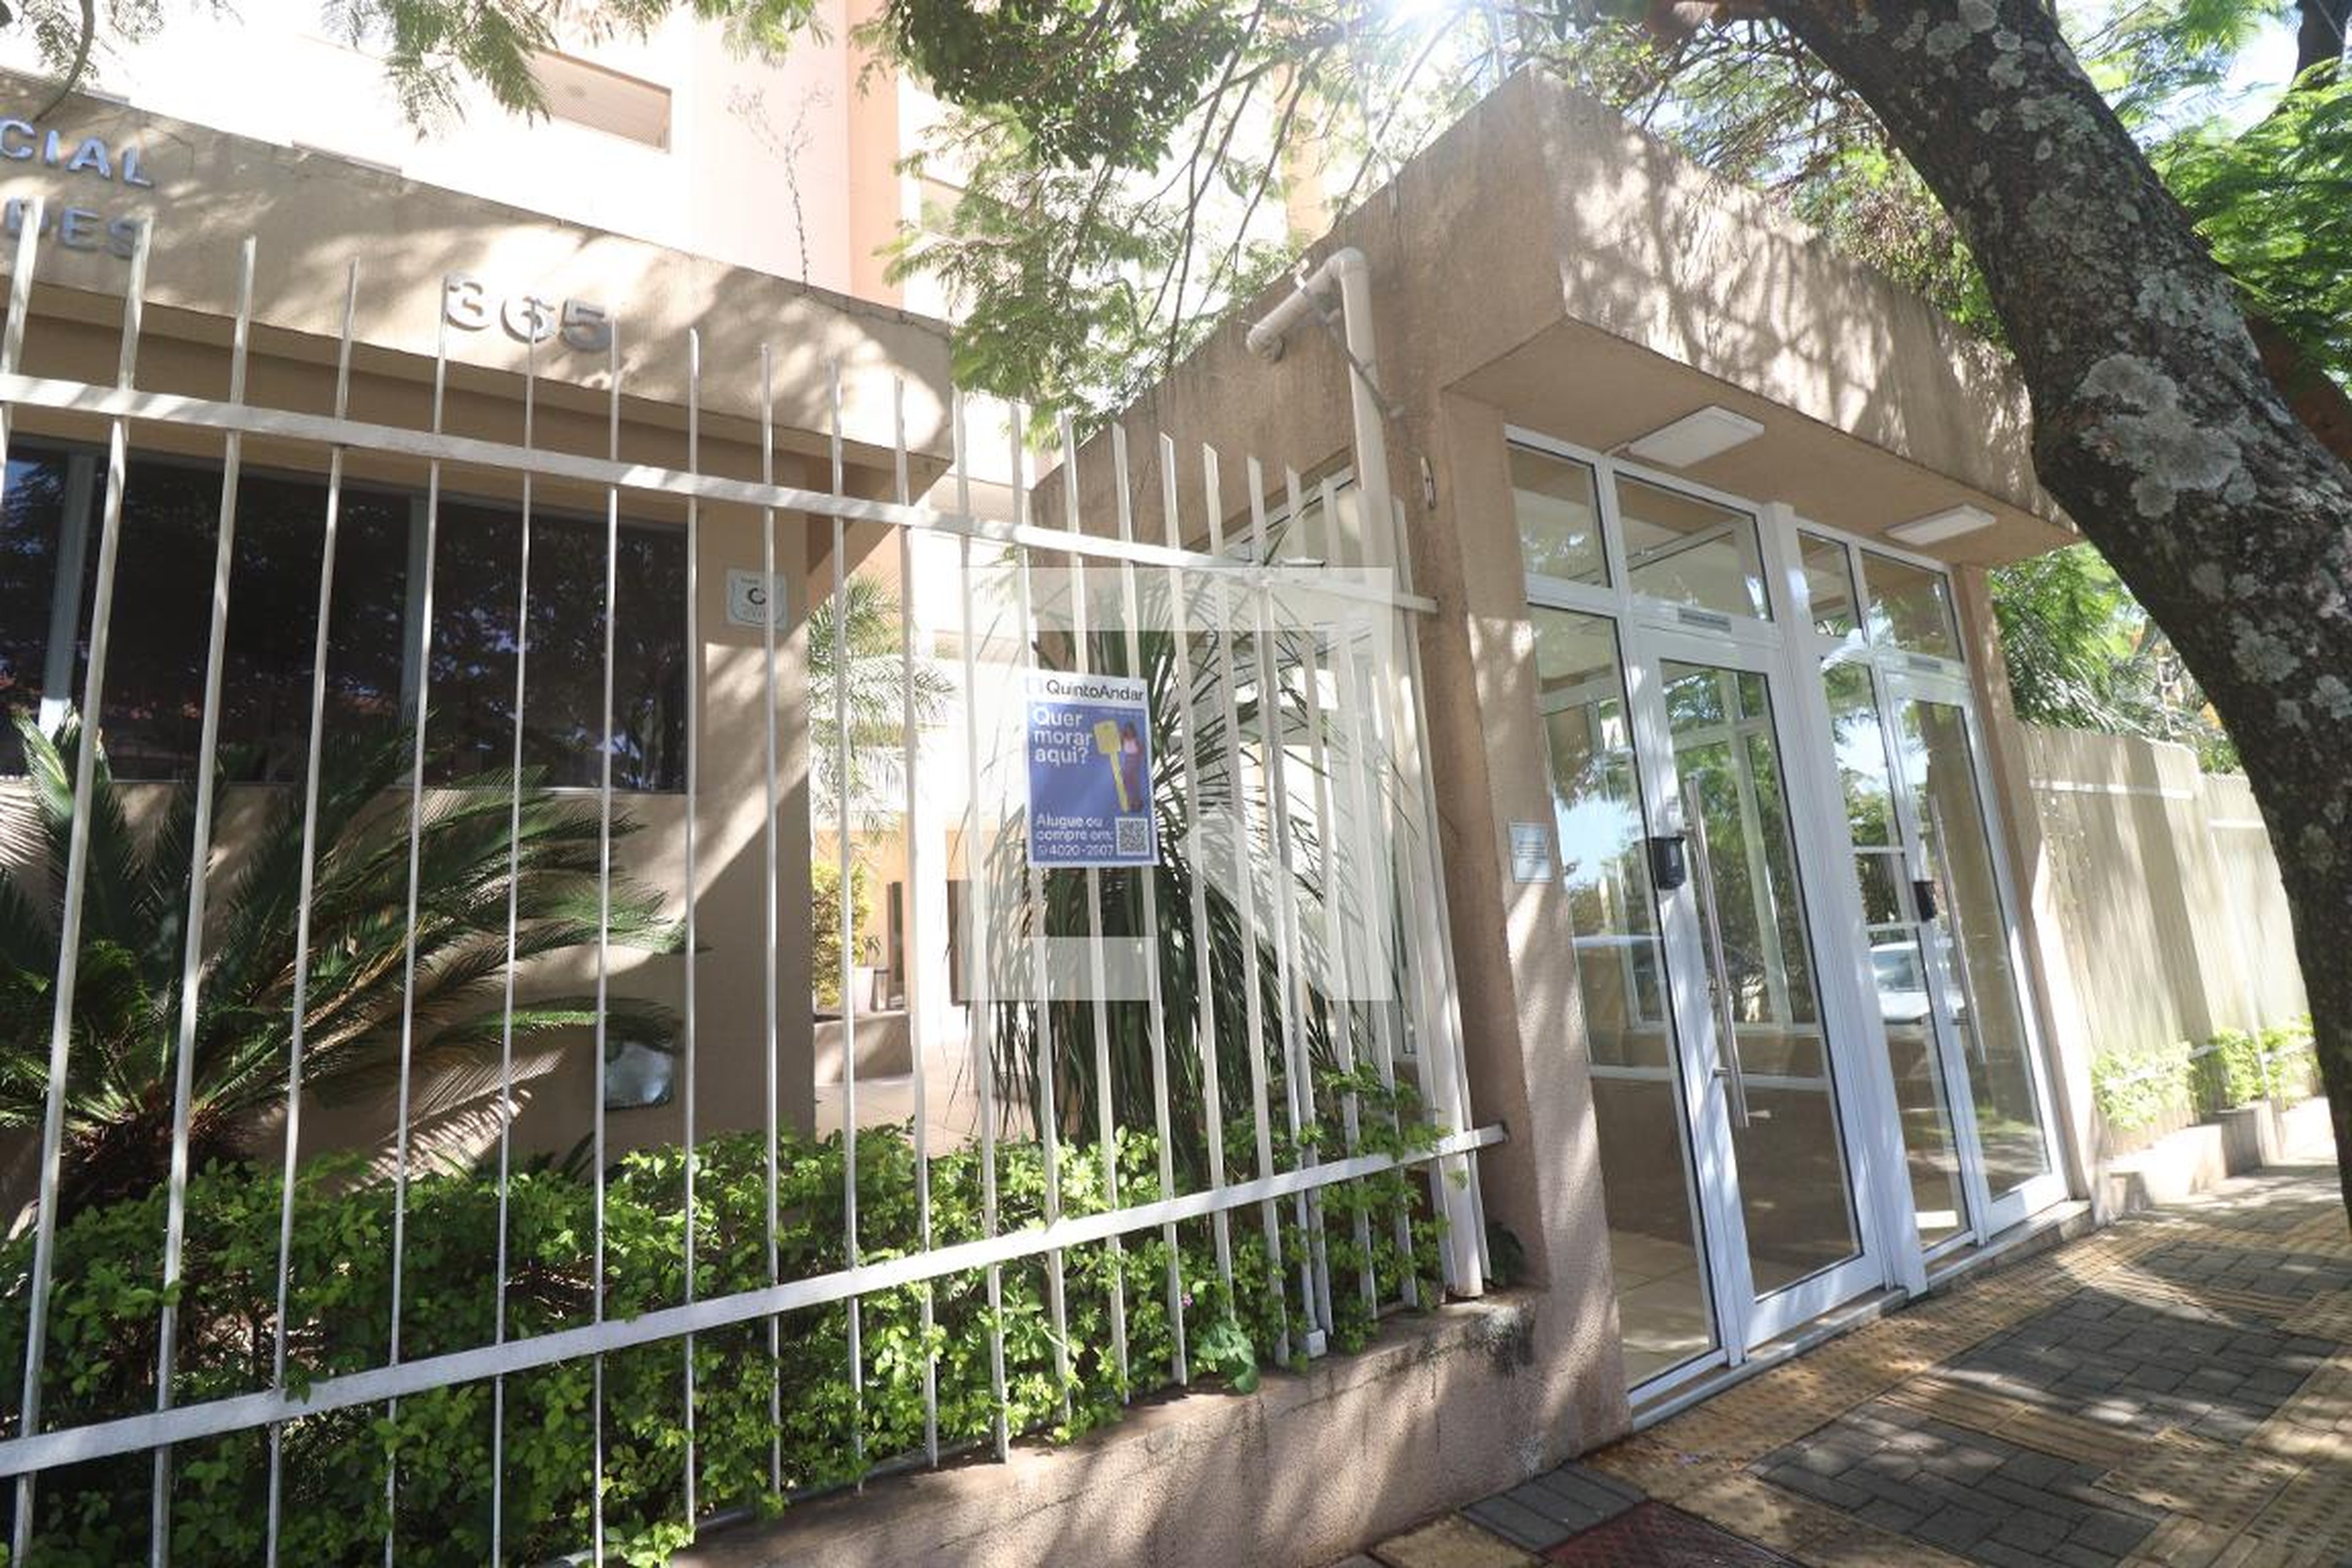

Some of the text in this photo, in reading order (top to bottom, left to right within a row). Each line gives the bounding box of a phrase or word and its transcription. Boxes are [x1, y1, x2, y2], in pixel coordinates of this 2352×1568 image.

[0, 118, 153, 187] CIAL
[445, 273, 612, 352] 365
[1046, 679, 1144, 701] QuintoAndar
[1032, 707, 1083, 727] Quer
[1034, 729, 1093, 747] morar
[1035, 745, 1089, 766] aqui?
[1036, 813, 1102, 829] Alugue ou
[1036, 829, 1088, 843] compre
